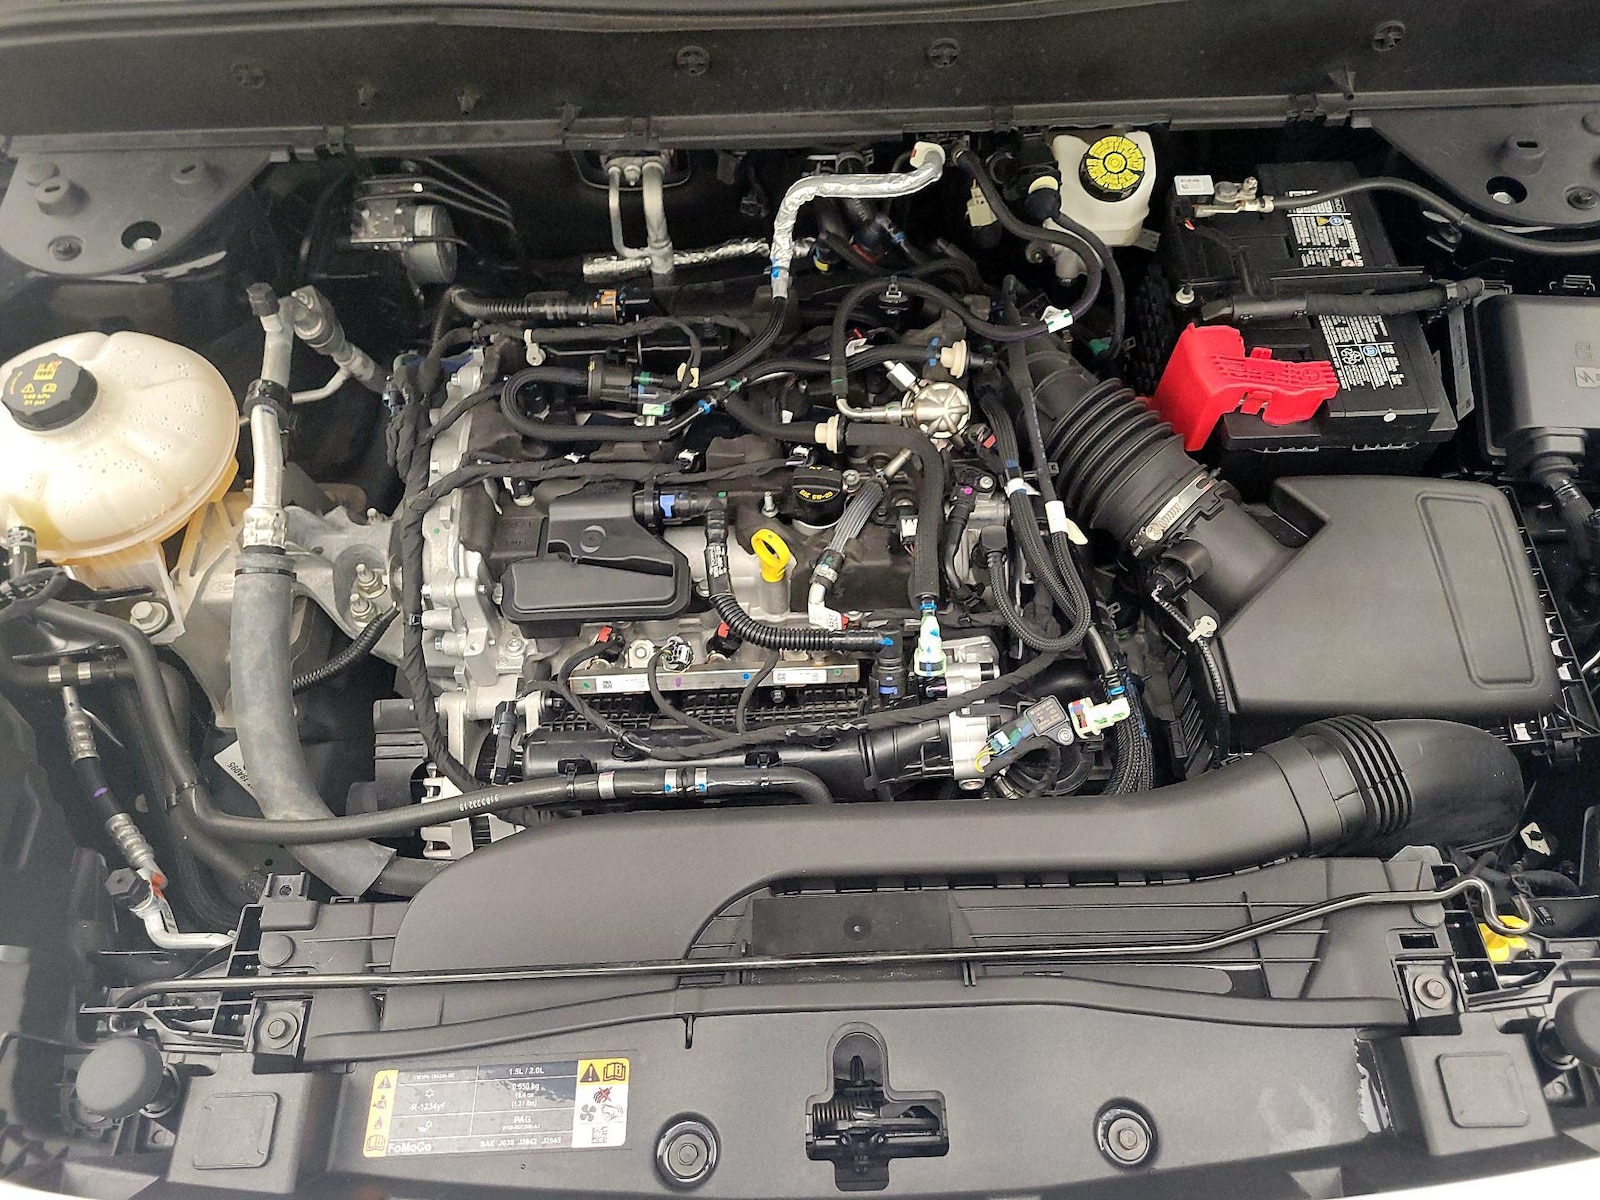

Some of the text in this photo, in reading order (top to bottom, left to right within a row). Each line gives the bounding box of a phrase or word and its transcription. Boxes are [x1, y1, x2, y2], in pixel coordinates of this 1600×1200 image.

[529, 1066, 545, 1075] 2.0L
[531, 1082, 540, 1092] kg
[411, 1101, 446, 1112] R-1234yf
[513, 1115, 532, 1124] PAG
[387, 1140, 432, 1153] FoMoCo
